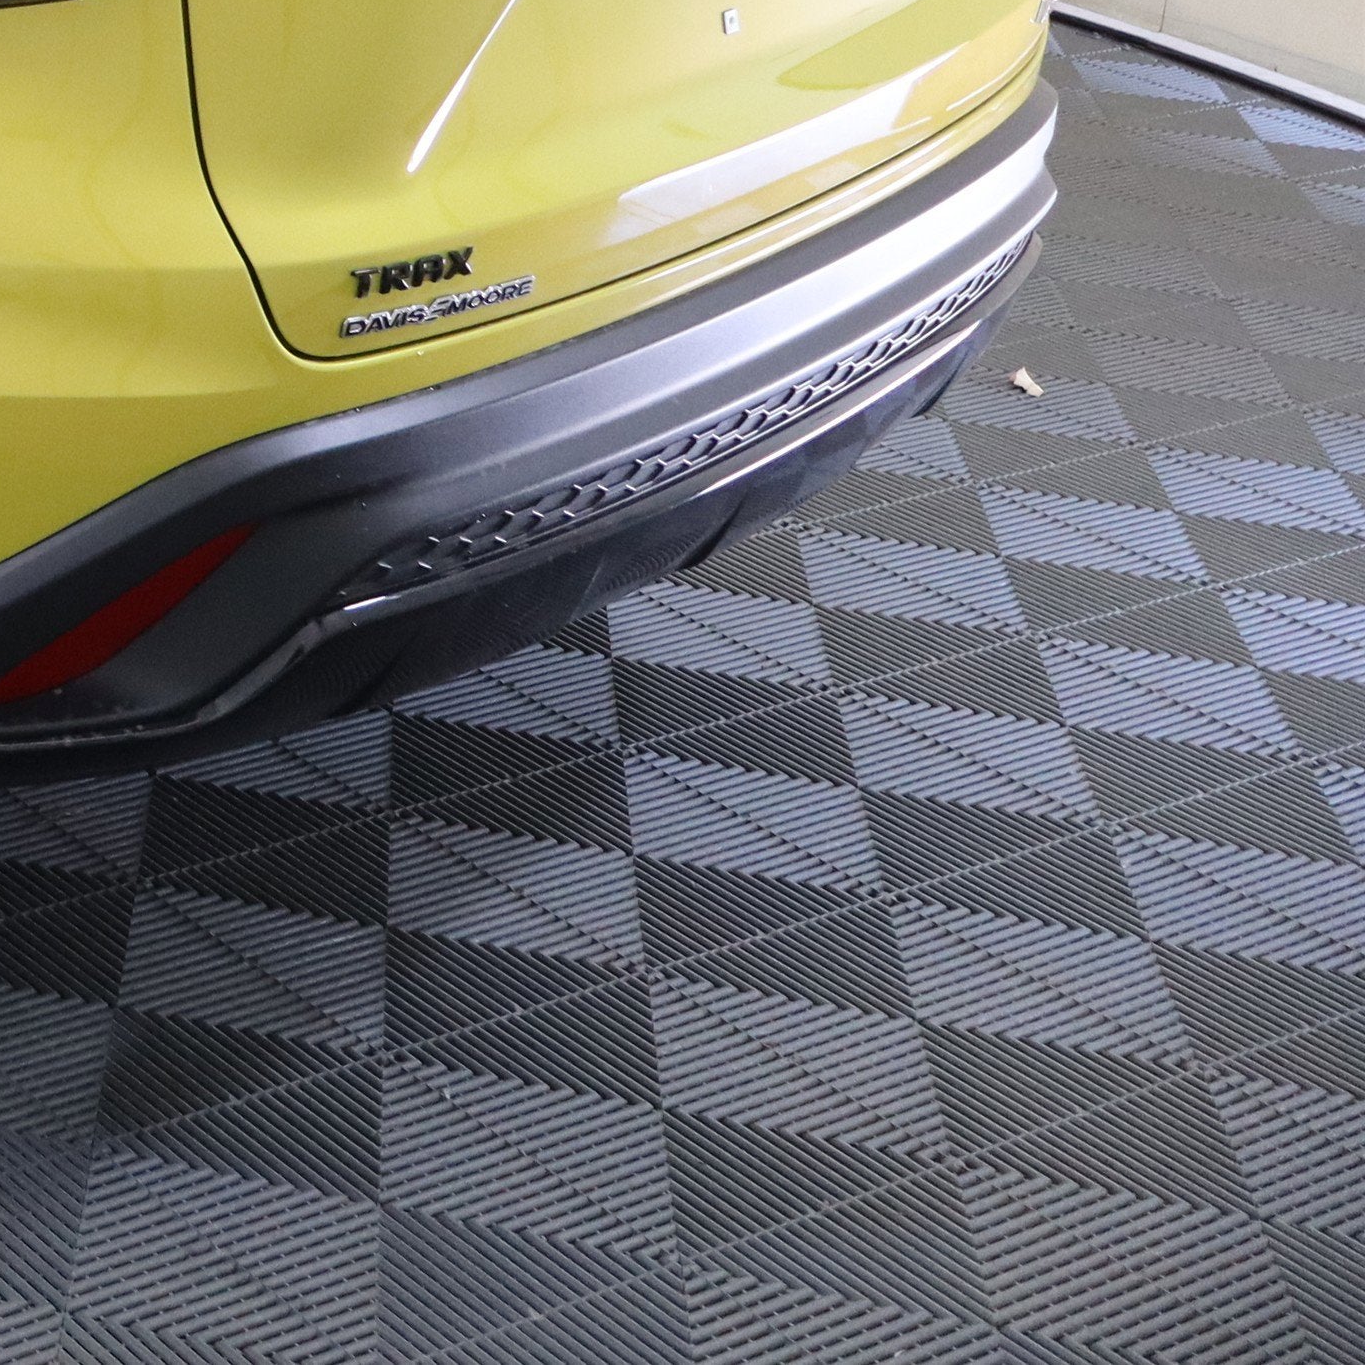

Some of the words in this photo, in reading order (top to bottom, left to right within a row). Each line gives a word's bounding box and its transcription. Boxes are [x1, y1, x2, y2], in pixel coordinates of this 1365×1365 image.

[351, 246, 474, 299] TRAX
[342, 304, 430, 337] DAVIS
[444, 275, 536, 317] MOORE
